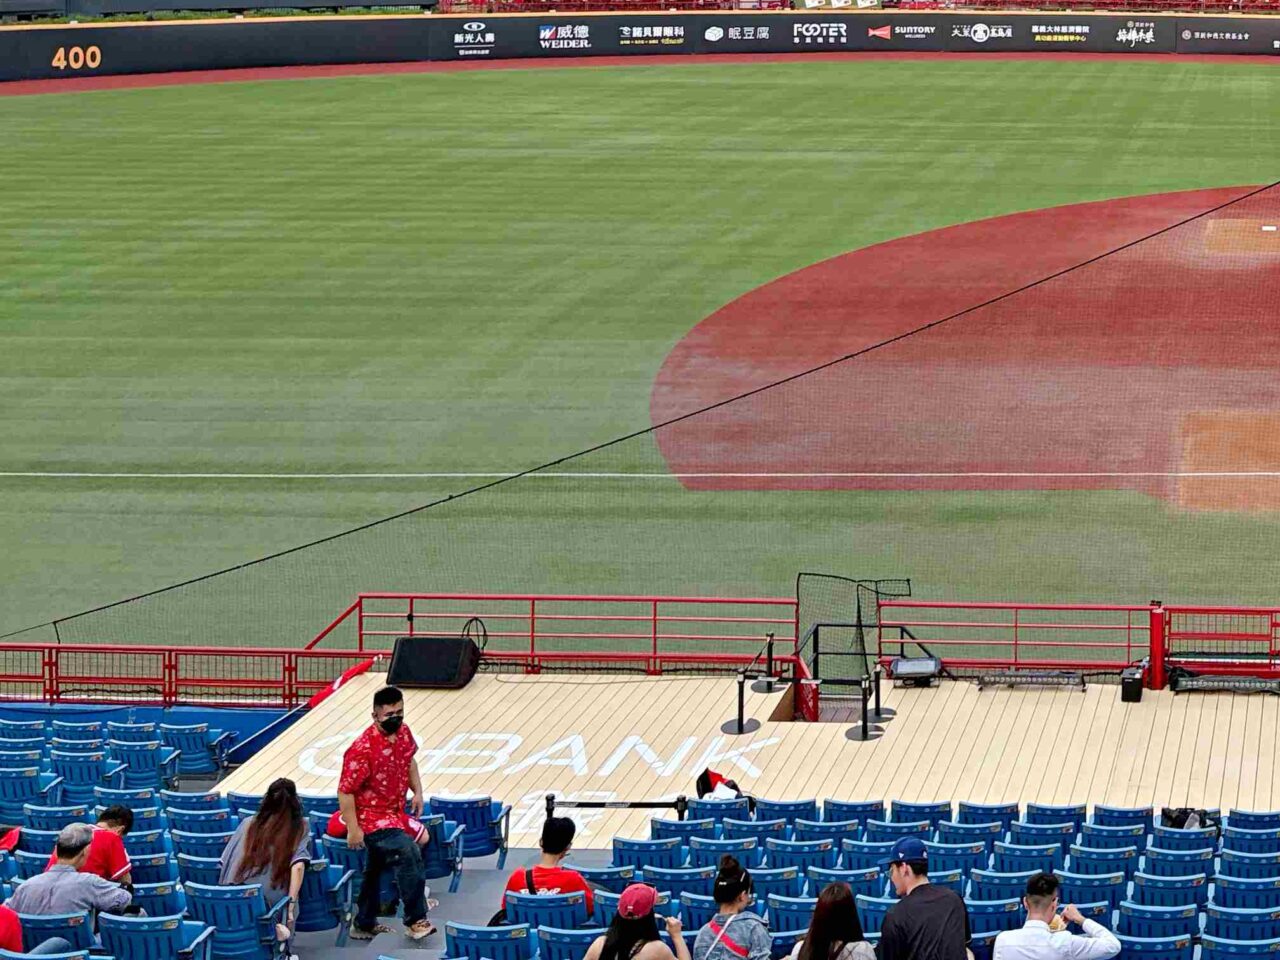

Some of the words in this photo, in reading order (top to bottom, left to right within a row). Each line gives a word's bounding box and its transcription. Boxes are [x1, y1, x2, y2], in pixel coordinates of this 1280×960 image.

[556, 25, 590, 38] 威德
[728, 27, 770, 40] 眠豆腐
[793, 23, 848, 37] FOOTER
[454, 33, 495, 44] 新光人壽
[540, 39, 592, 49] WEIDER
[51, 45, 102, 70] 400
